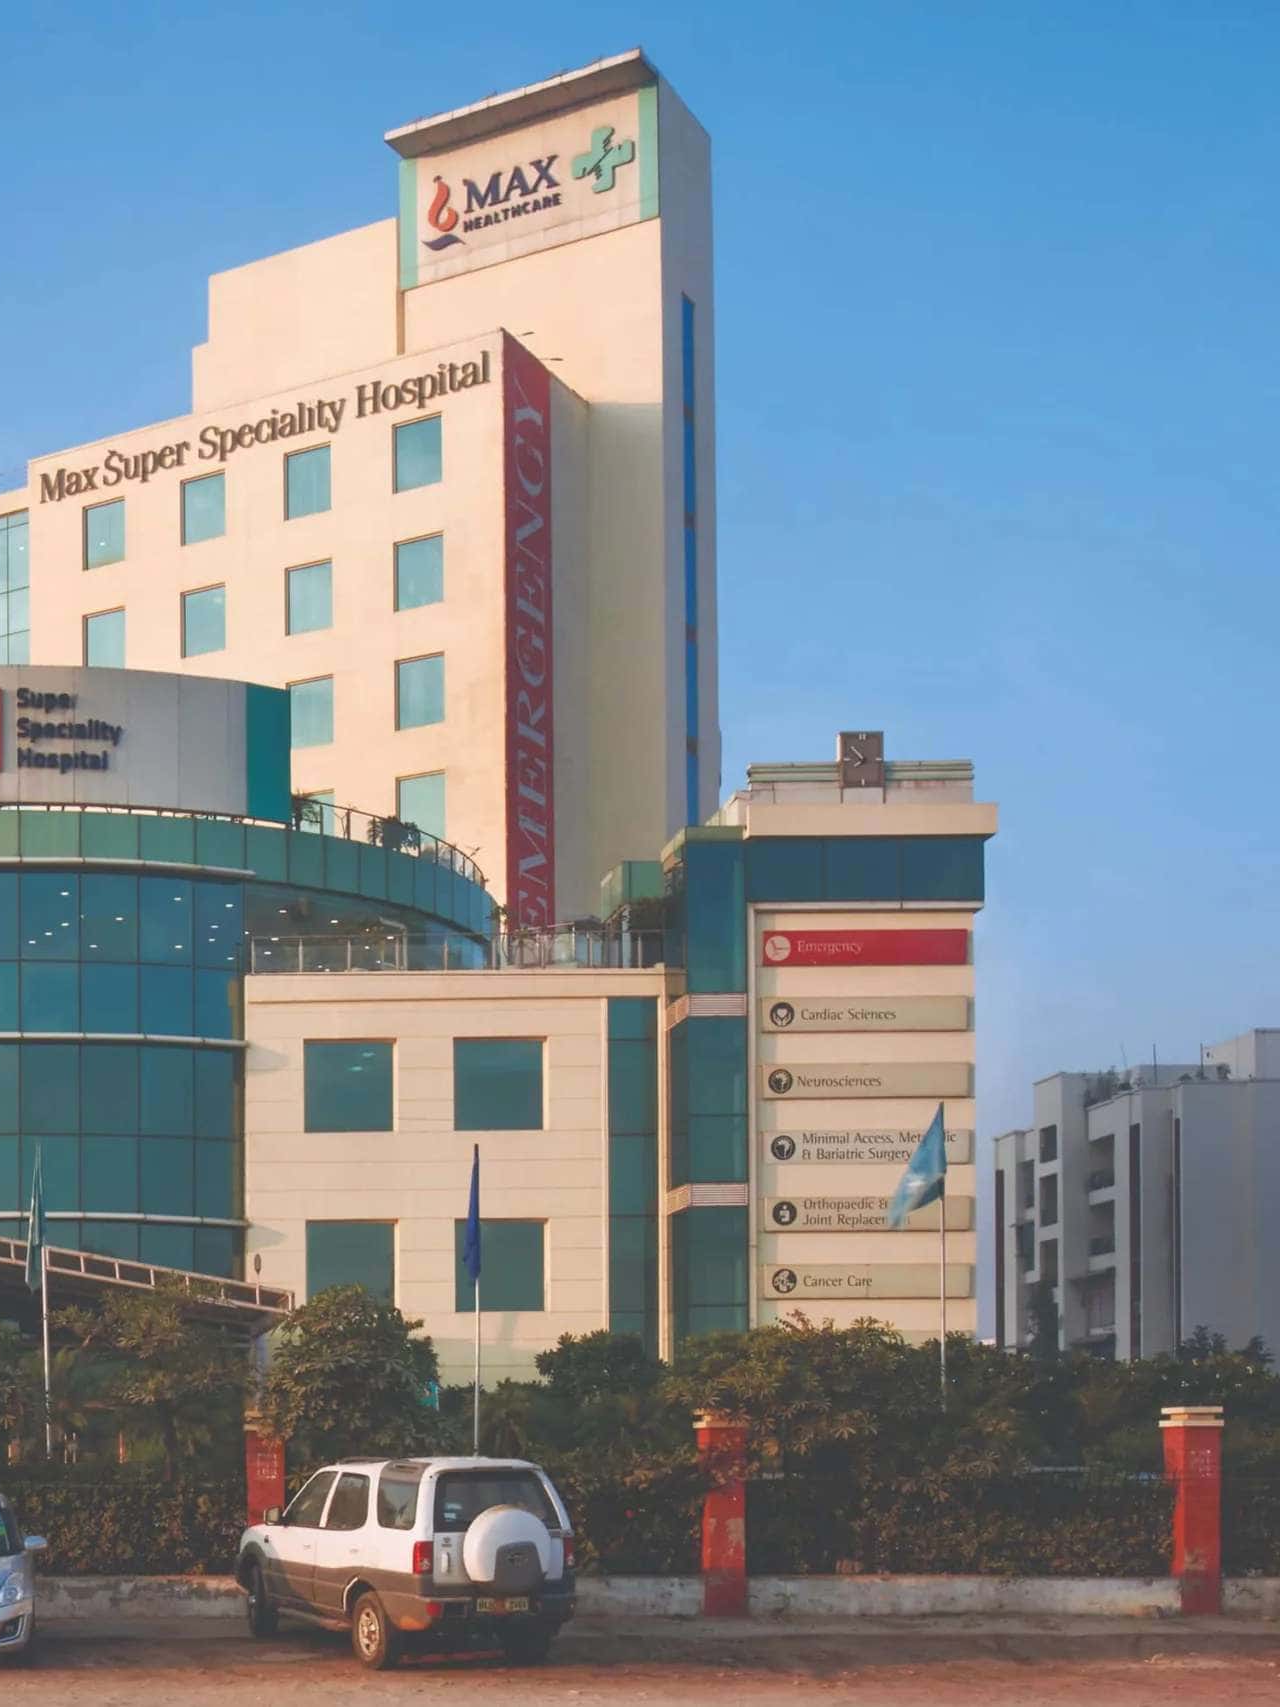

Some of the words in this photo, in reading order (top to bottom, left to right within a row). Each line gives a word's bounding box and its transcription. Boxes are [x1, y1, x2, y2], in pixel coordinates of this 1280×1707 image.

[463, 154, 561, 214] MAX
[463, 192, 563, 232] HEALTHCARE
[40, 465, 100, 503] Max
[103, 439, 191, 486] Super
[198, 398, 347, 461] Speciality
[356, 351, 491, 418] Hospital
[513, 368, 548, 932] EMERGENCY
[17, 687, 78, 714] Super
[17, 717, 123, 747] Speciality
[17, 747, 109, 775] Hospital
[797, 940, 863, 955] Emergency
[801, 1008, 844, 1020] Cardiac
[847, 1007, 897, 1020] Sciences
[797, 1075, 882, 1088] Neurosciences
[802, 1132, 850, 1145] Minimal
[854, 1132, 894, 1145] Access,
[899, 1131, 957, 1144] Metic
[802, 1149, 812, 1160] &
[816, 1149, 864, 1160] Bariatric
[868, 1149, 912, 1162] Surgery
[803, 1198, 873, 1213] Orthopaedic
[802, 1213, 833, 1226] Joint
[803, 1275, 843, 1287] Cancer
[847, 1275, 873, 1287] Care
